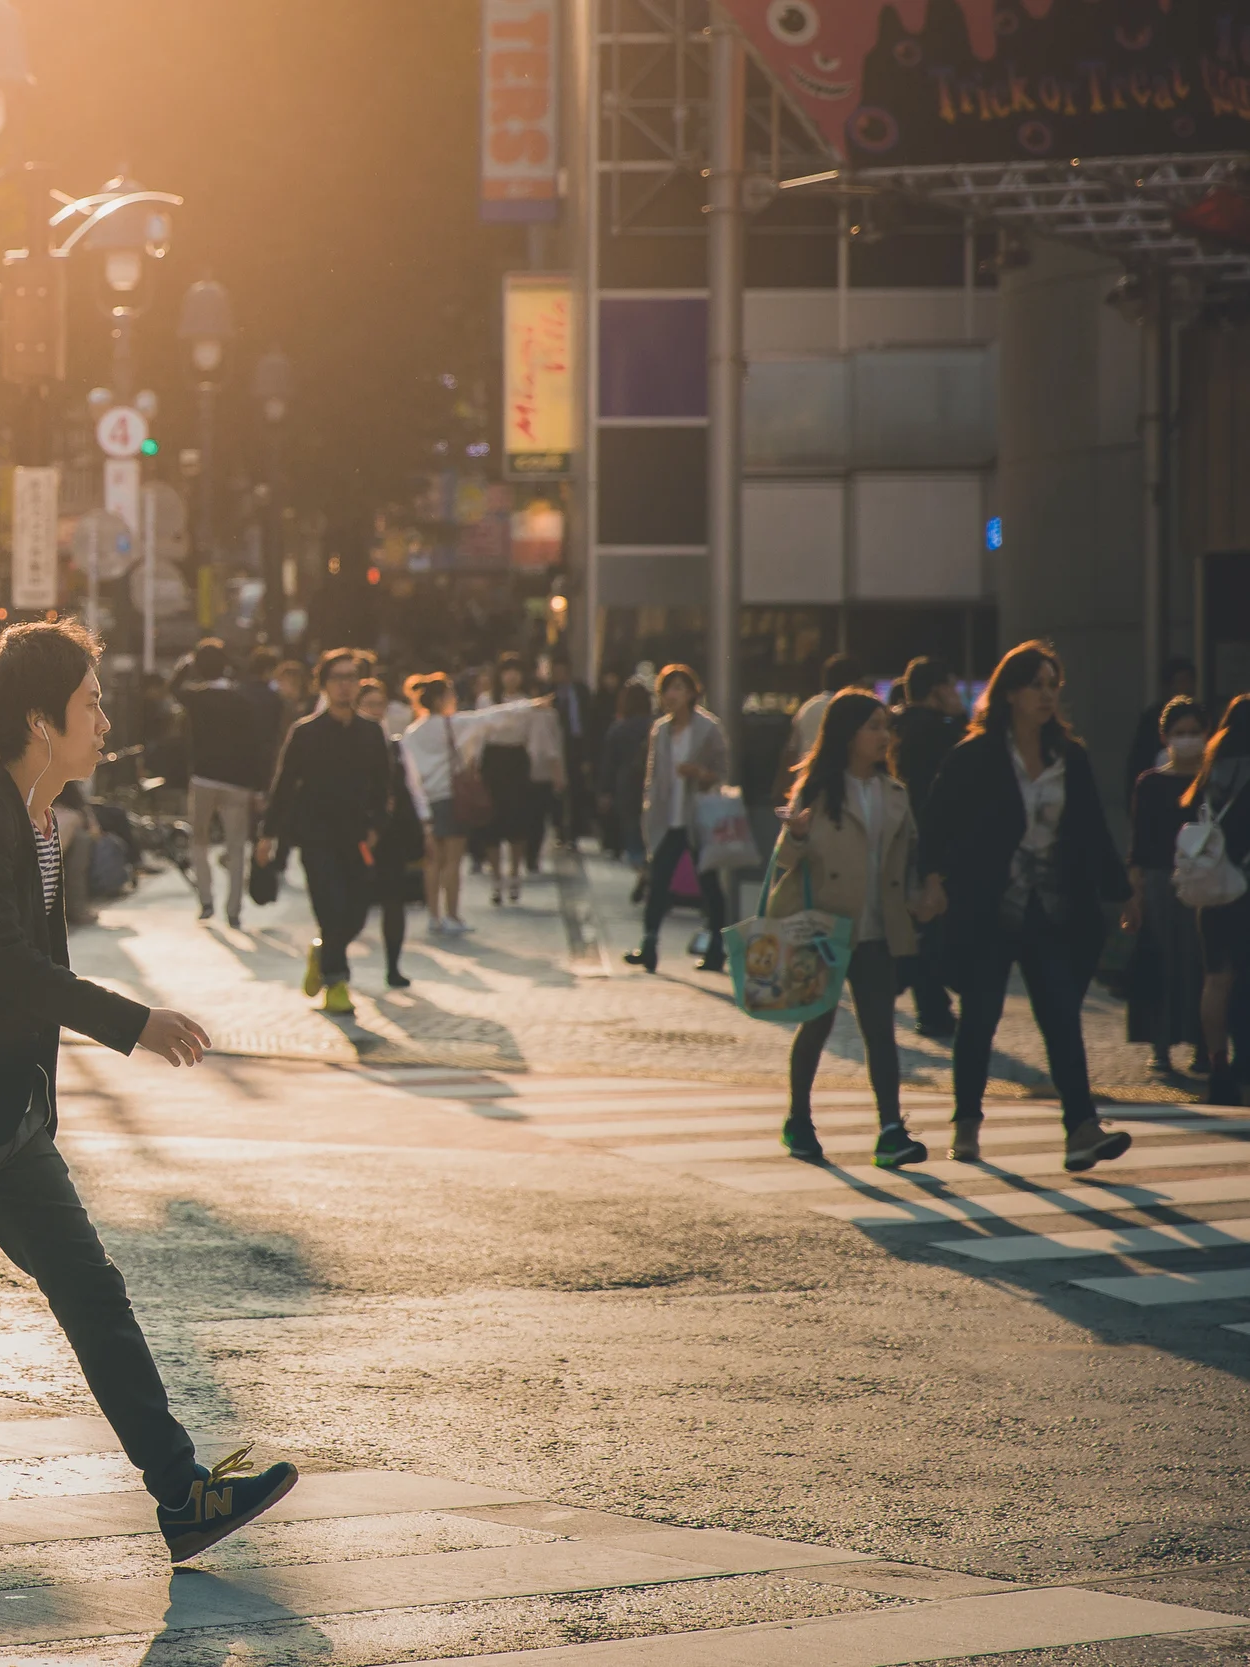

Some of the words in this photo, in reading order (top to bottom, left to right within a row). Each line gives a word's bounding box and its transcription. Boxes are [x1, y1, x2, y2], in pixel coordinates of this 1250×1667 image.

[490, 0, 550, 166] TERS
[1077, 57, 1191, 114] Treat
[108, 415, 130, 446] 4
[205, 1486, 234, 1520] N
